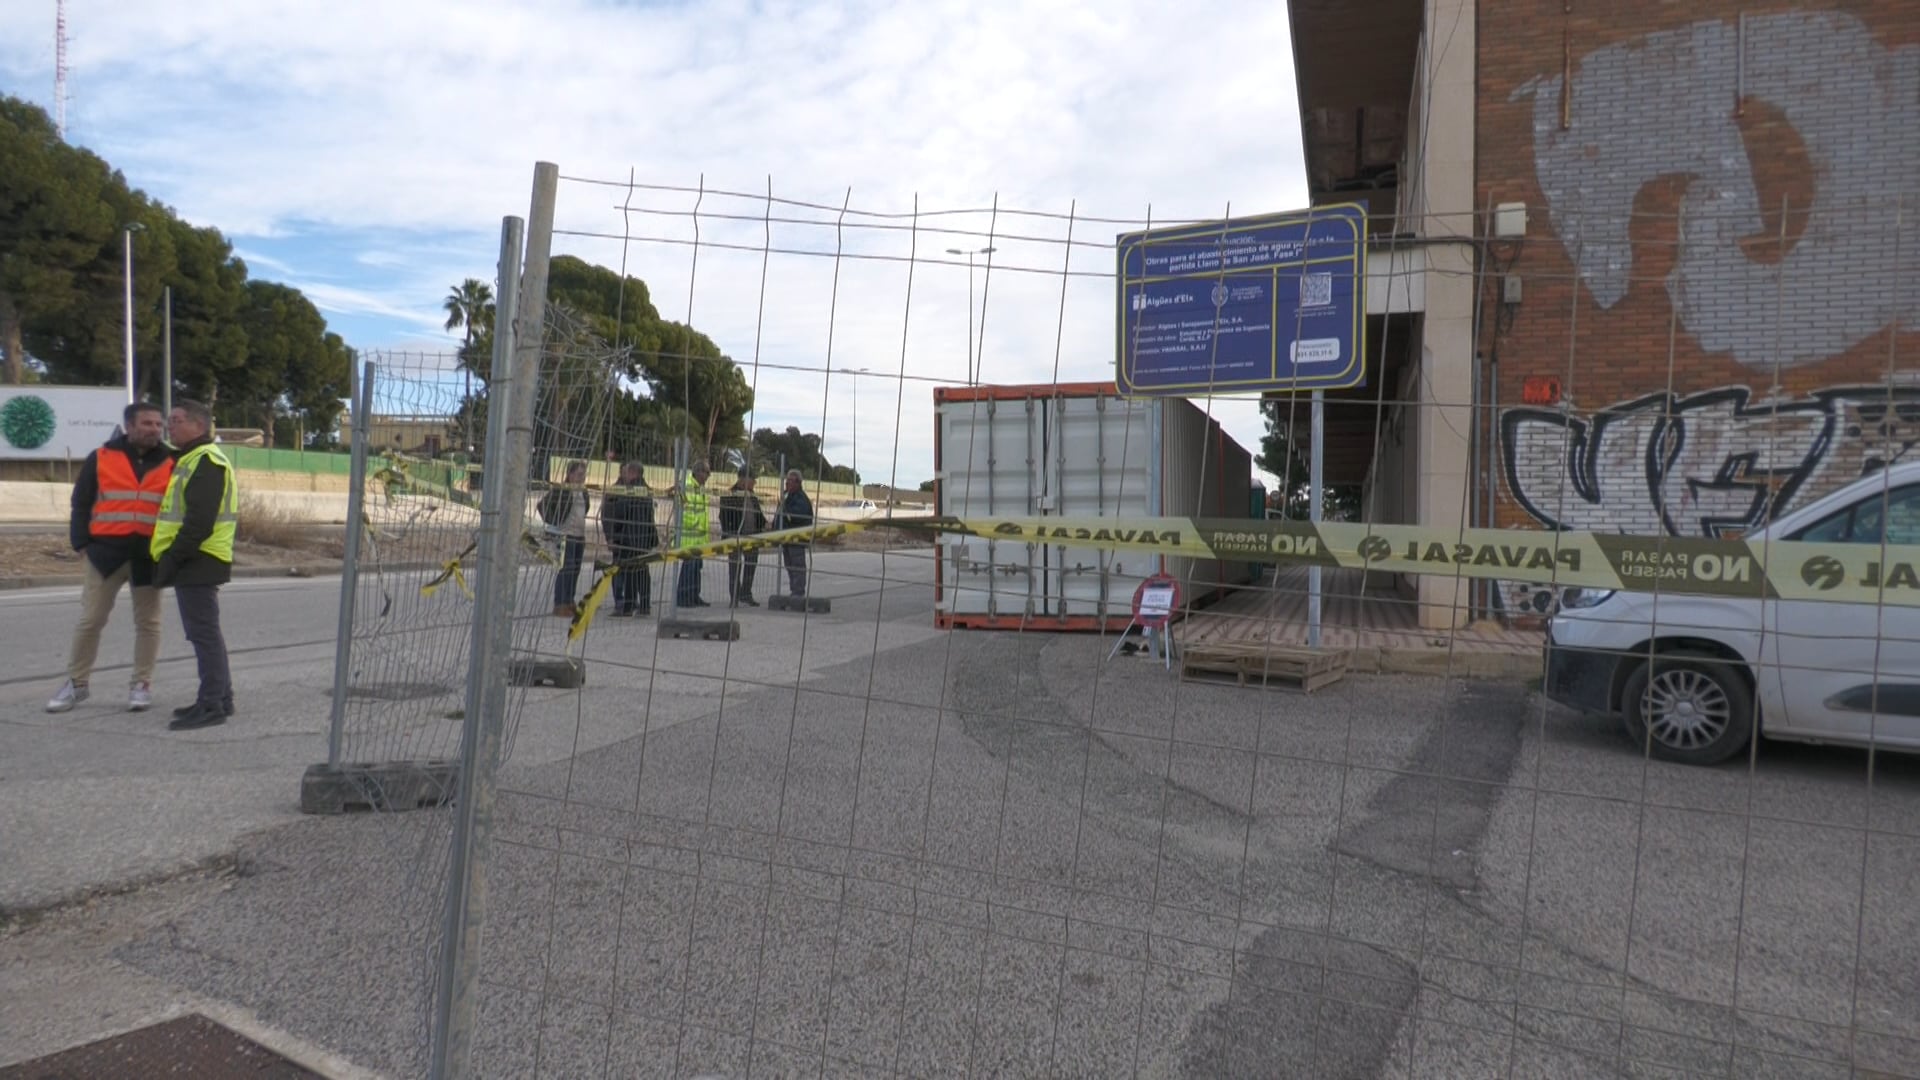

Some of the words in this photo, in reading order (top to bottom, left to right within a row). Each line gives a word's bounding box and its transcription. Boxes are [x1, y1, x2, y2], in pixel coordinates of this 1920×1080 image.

[1146, 257, 1168, 265] Obras
[1197, 246, 1257, 259] abastcimiento
[1258, 244, 1269, 252] de
[1271, 243, 1291, 254] agua
[1147, 296, 1172, 307] Aigües
